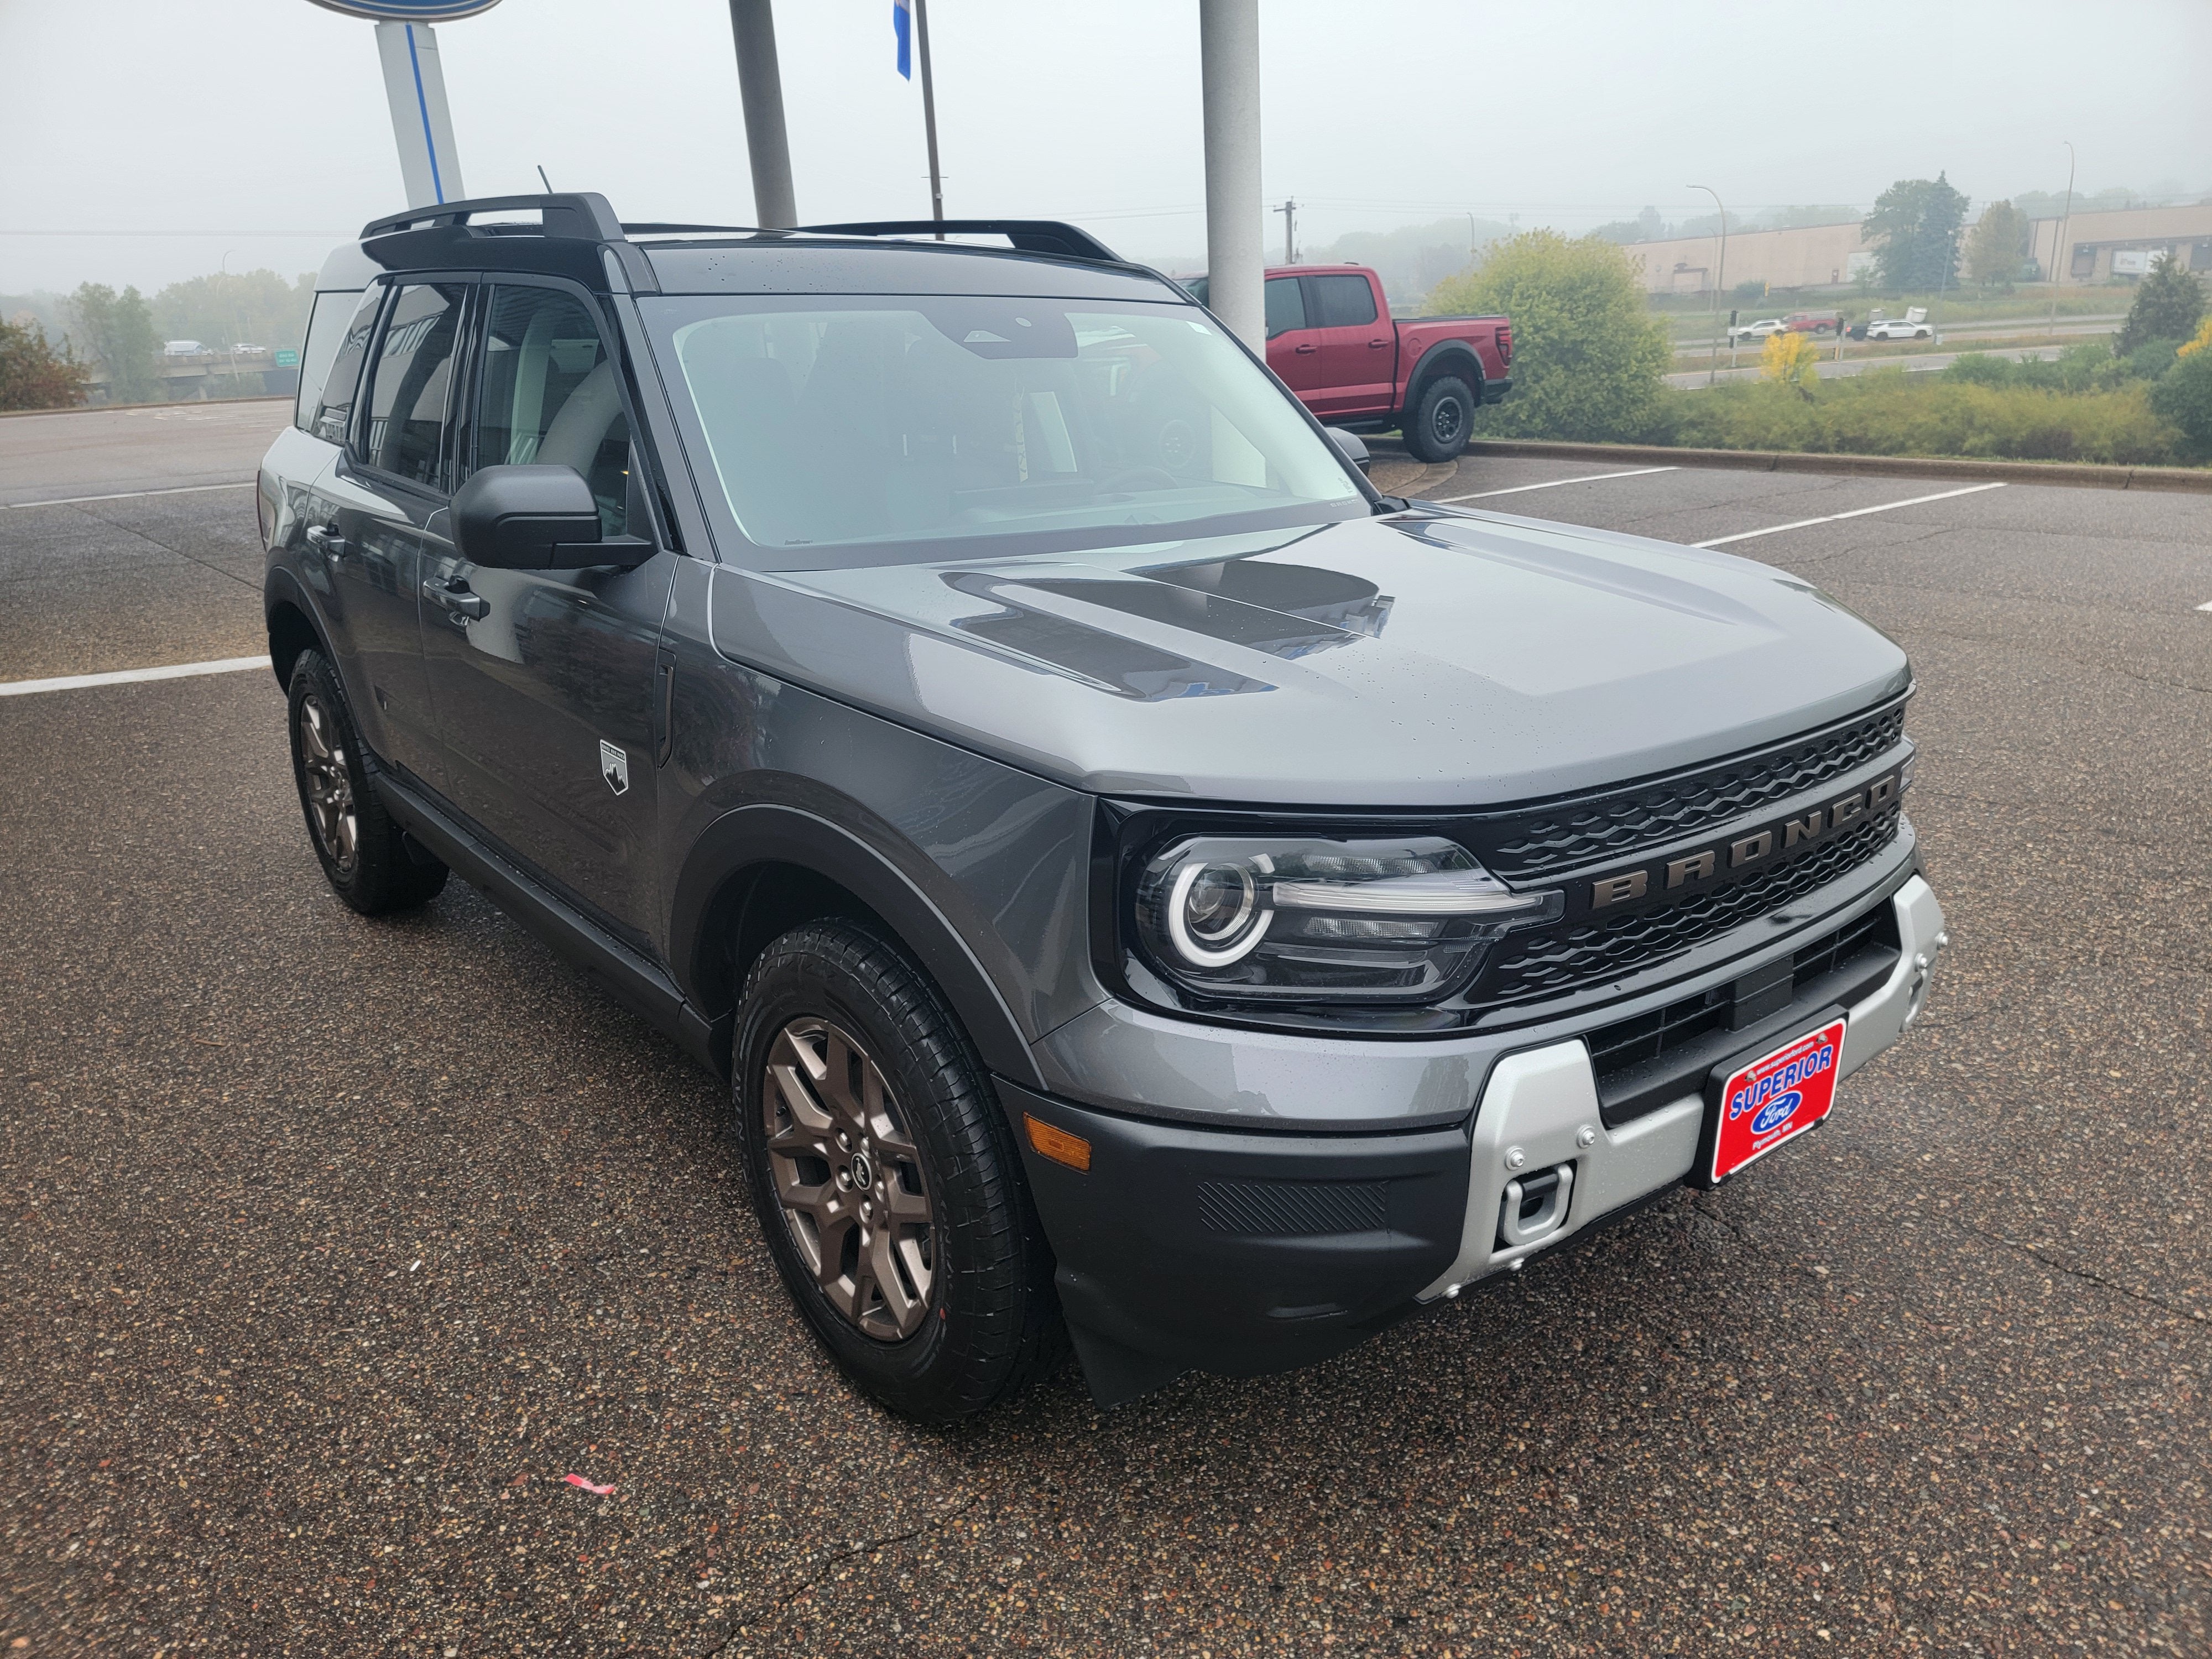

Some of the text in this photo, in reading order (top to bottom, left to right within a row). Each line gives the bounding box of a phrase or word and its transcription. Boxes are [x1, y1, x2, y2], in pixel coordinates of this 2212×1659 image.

[611, 748, 625, 760] BEND
[1590, 774, 1895, 910] BRONCO
[1729, 1044, 1834, 1120] SUPERIOR
[1760, 1097, 1793, 1128] Ford
[1782, 1121, 1793, 1133] MN
